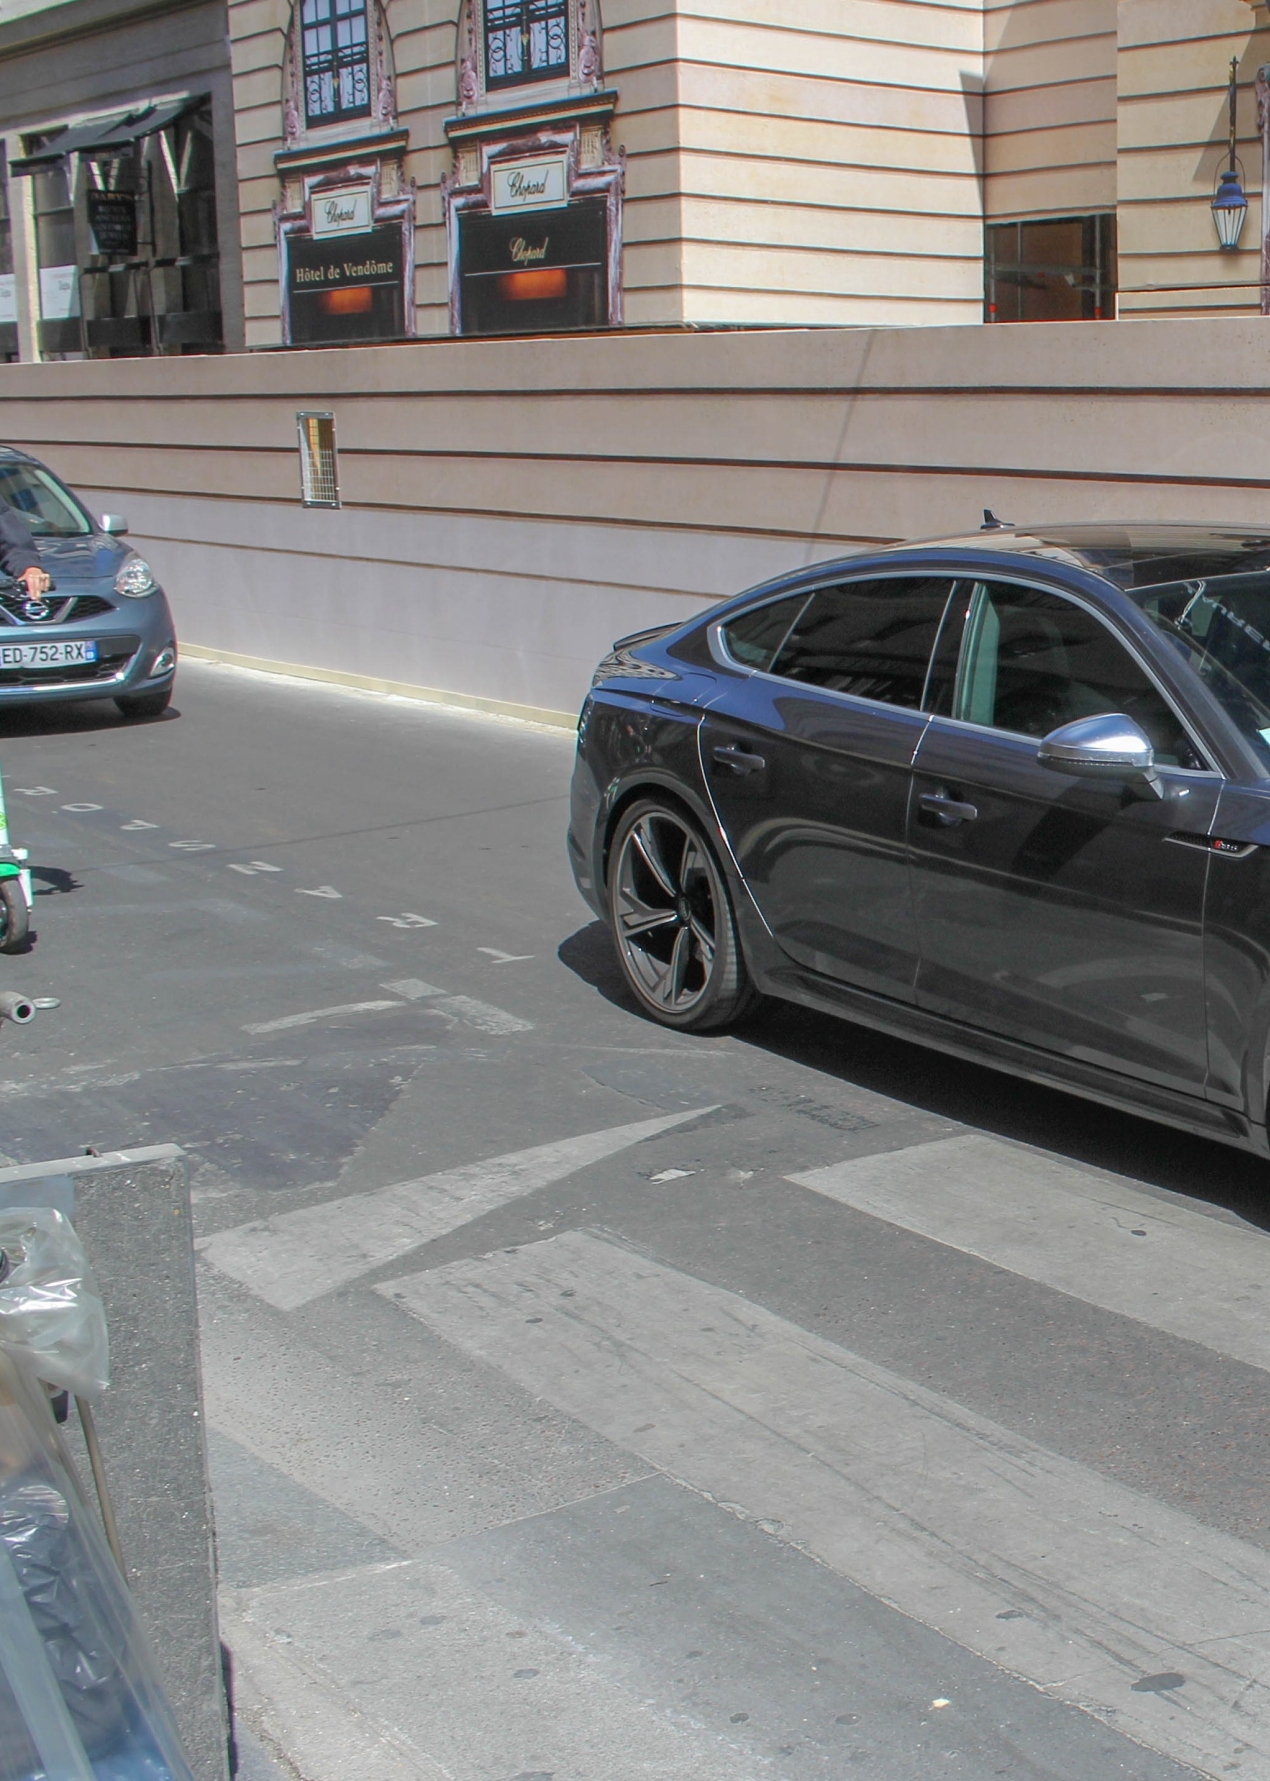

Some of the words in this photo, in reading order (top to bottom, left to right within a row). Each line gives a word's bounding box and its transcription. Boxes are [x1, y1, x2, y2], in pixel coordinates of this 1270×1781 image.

[507, 169, 549, 203] Chopard
[324, 199, 357, 228] Chopard
[510, 236, 549, 265] Chopard
[296, 266, 324, 282] Hôtel
[327, 264, 341, 280] de
[343, 260, 394, 277] Vendôme
[2, 643, 85, 664] ED-752-RX
